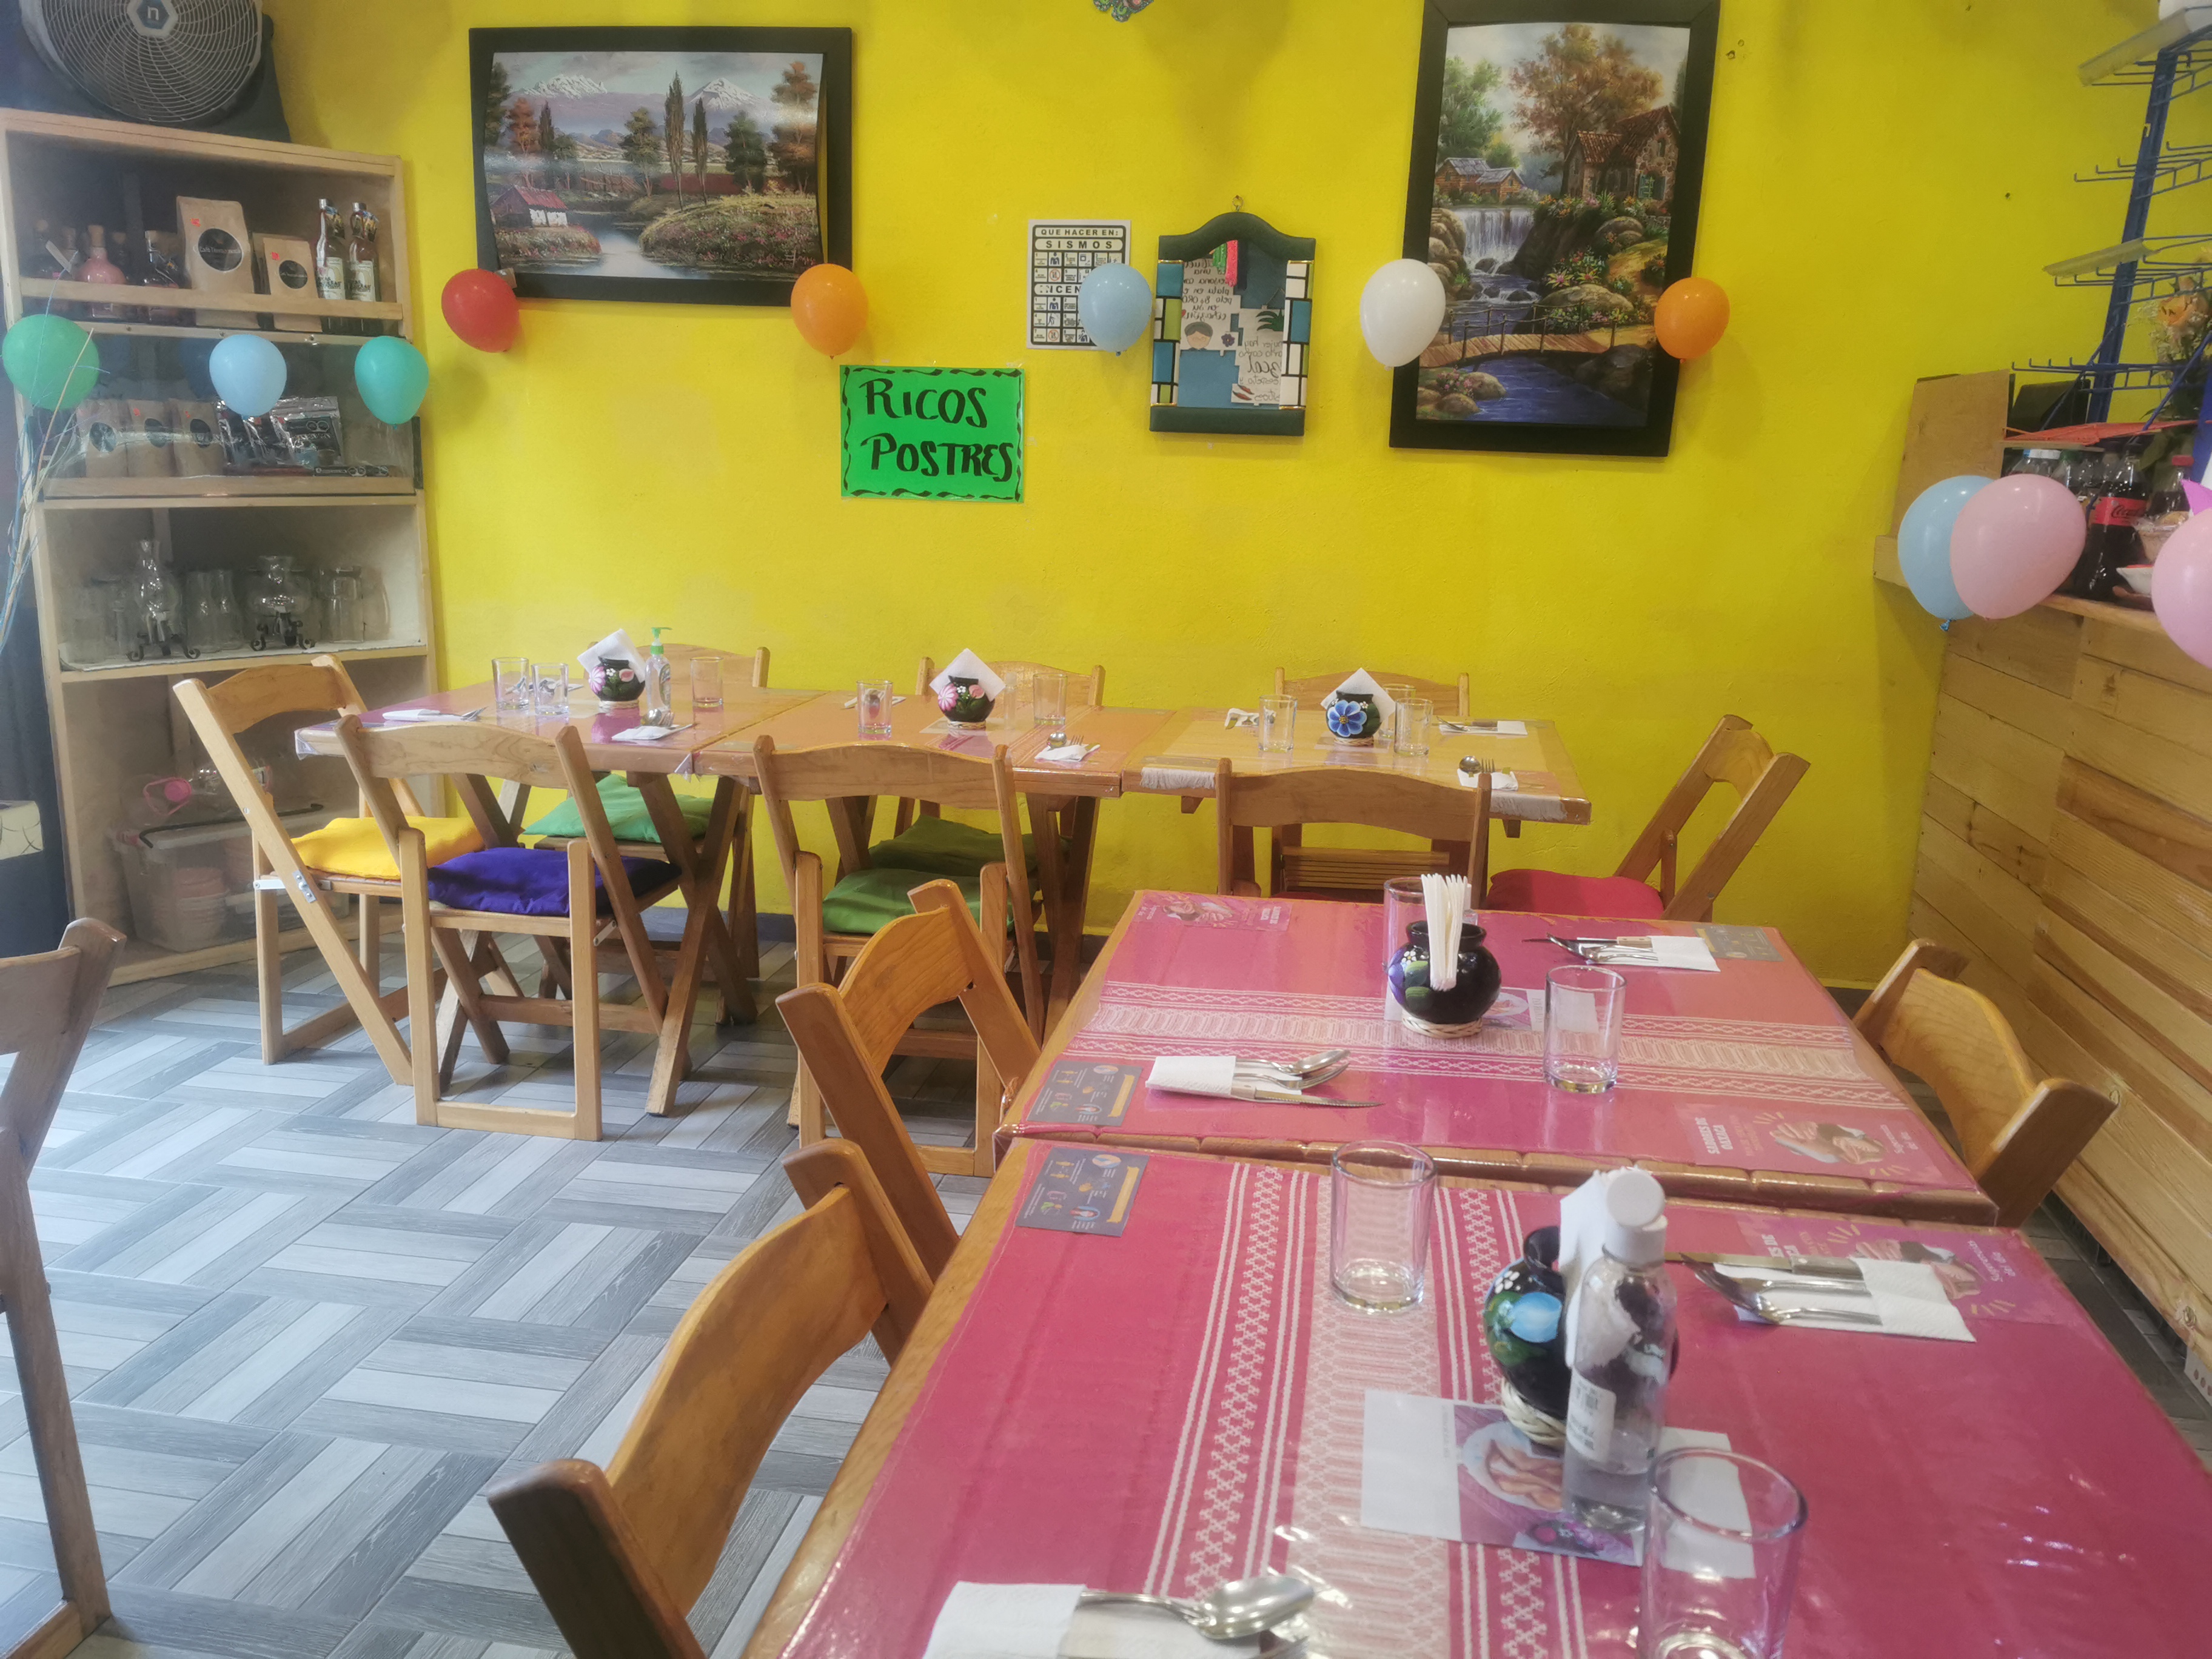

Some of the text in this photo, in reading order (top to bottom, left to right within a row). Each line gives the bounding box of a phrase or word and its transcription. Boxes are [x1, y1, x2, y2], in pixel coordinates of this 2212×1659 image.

[1046, 240, 1112, 249] SISMOS
[859, 378, 988, 428] RICOS
[860, 432, 1014, 482] POSTRES
